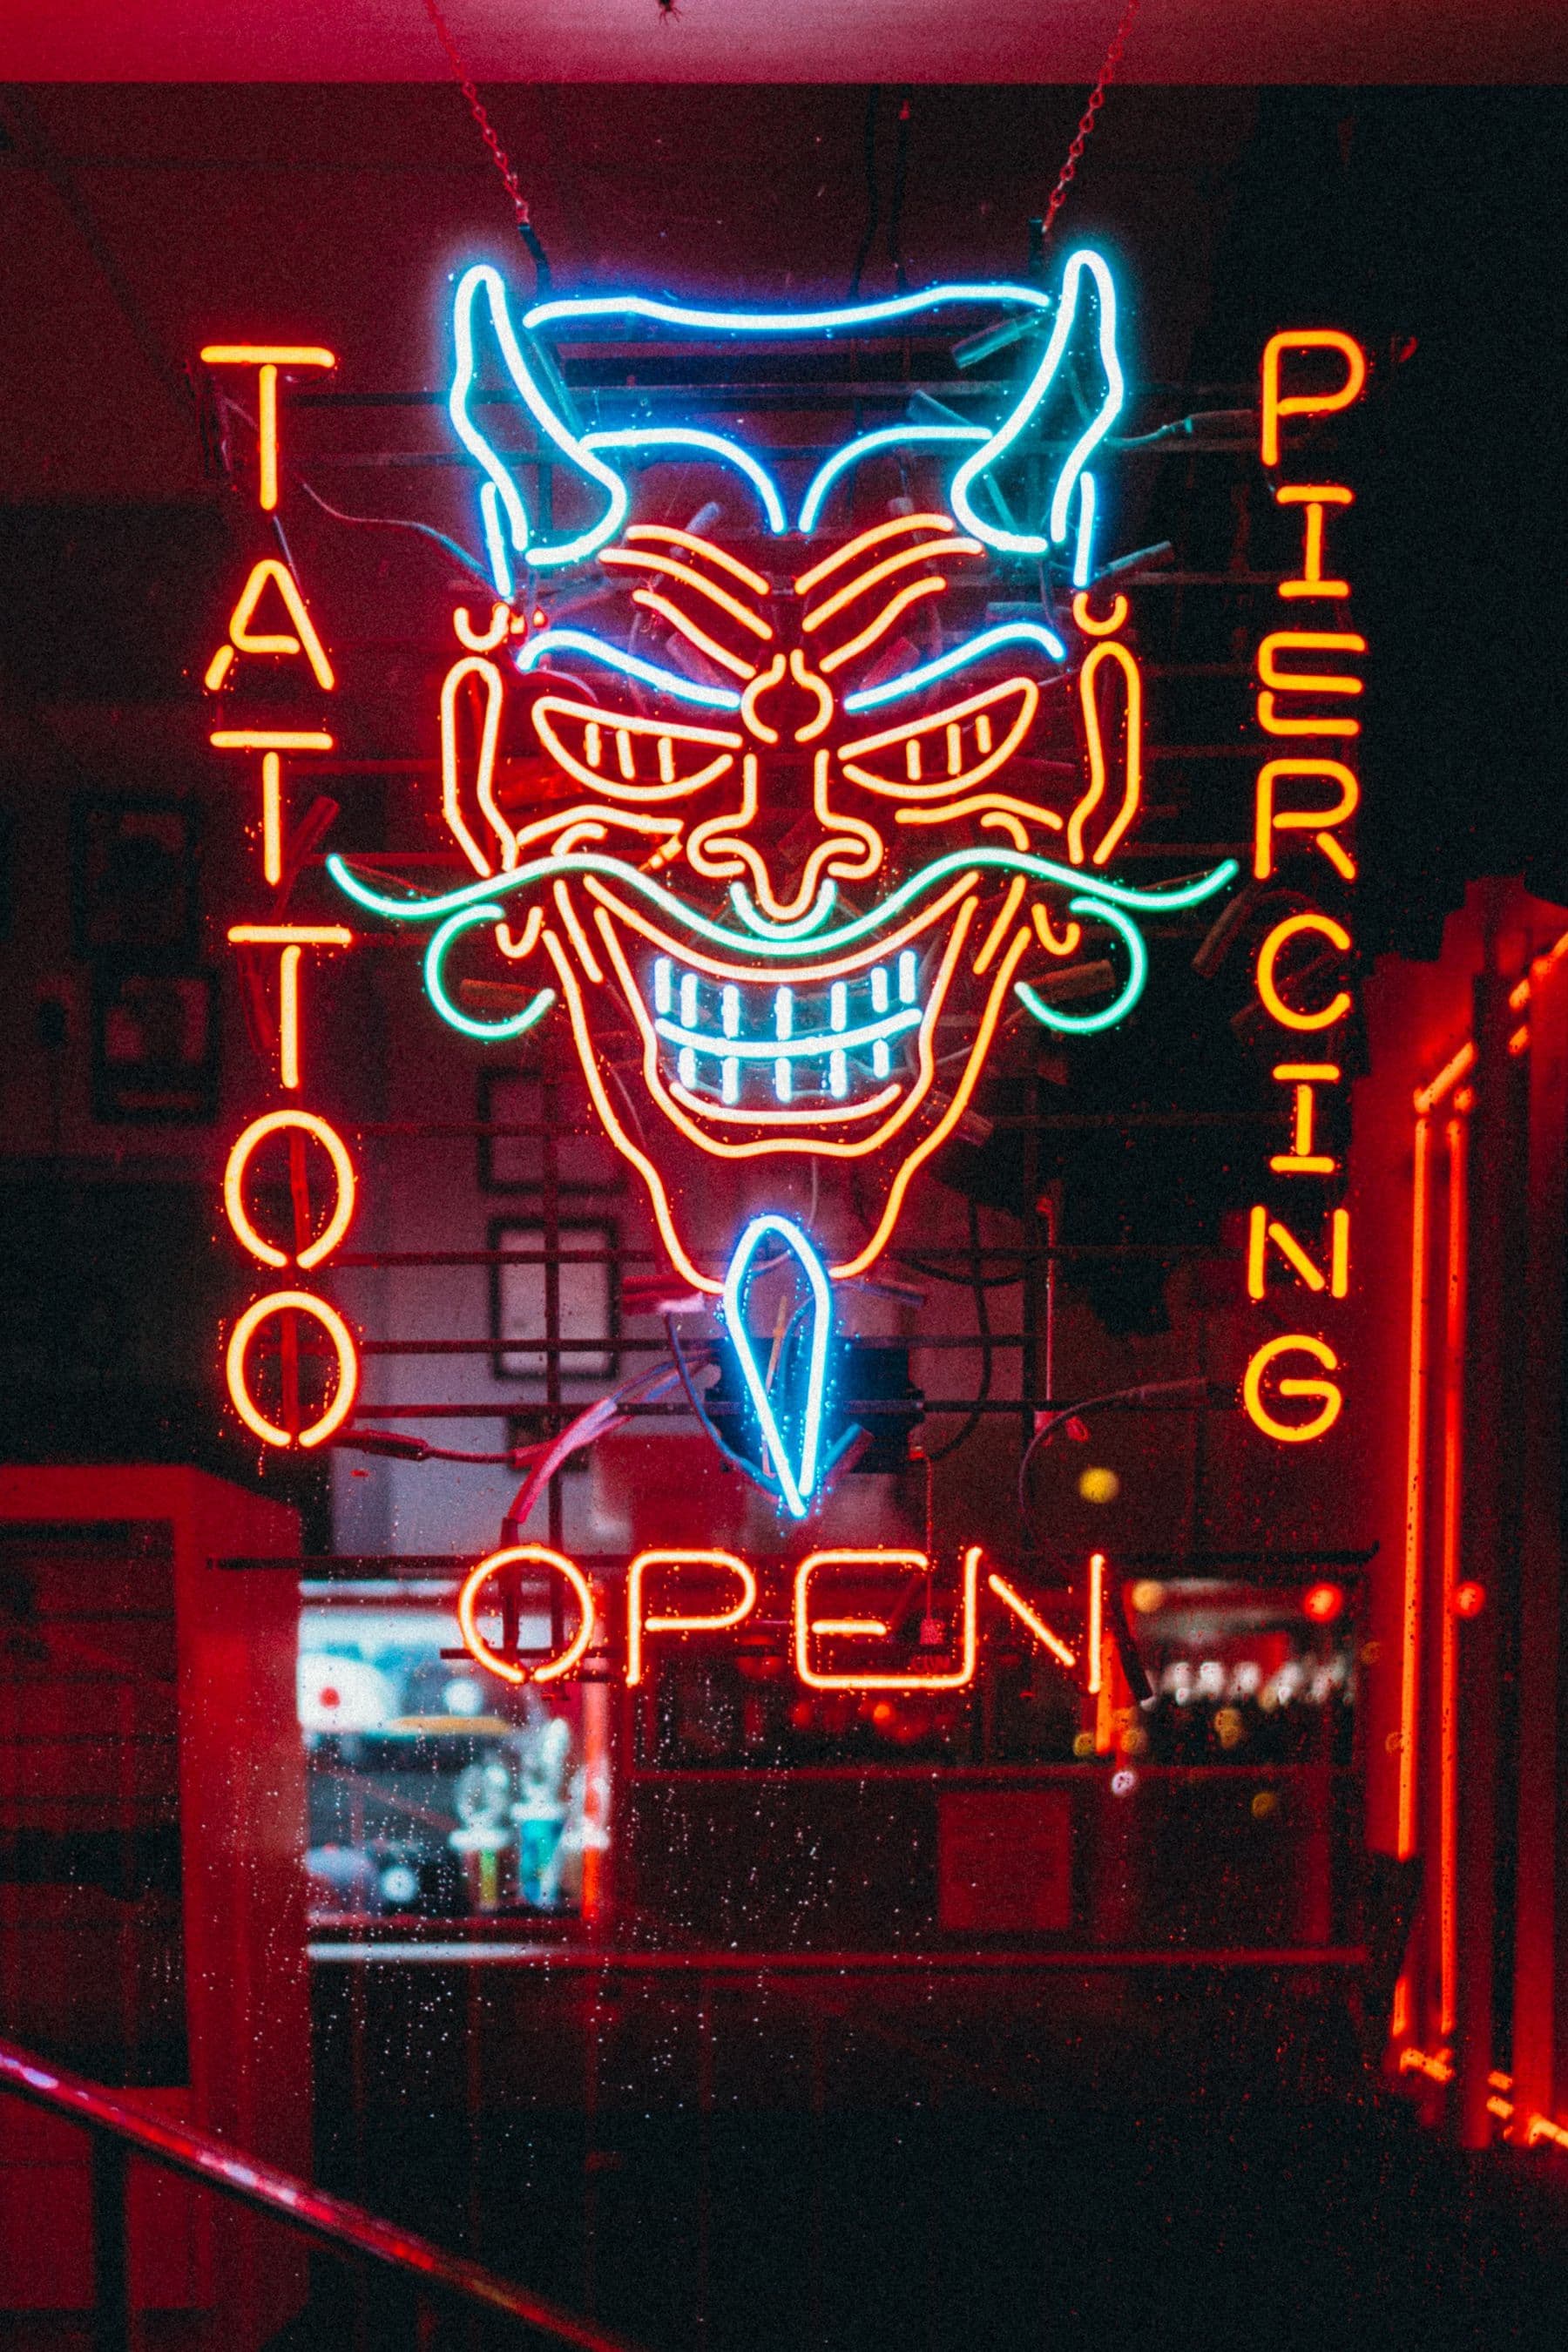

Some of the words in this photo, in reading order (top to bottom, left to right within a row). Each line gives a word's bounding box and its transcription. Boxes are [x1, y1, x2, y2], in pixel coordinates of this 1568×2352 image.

[199, 345, 358, 1448] TATTOO
[1242, 330, 1367, 1443] PIERCING
[458, 1544, 1105, 1694] OPEN
